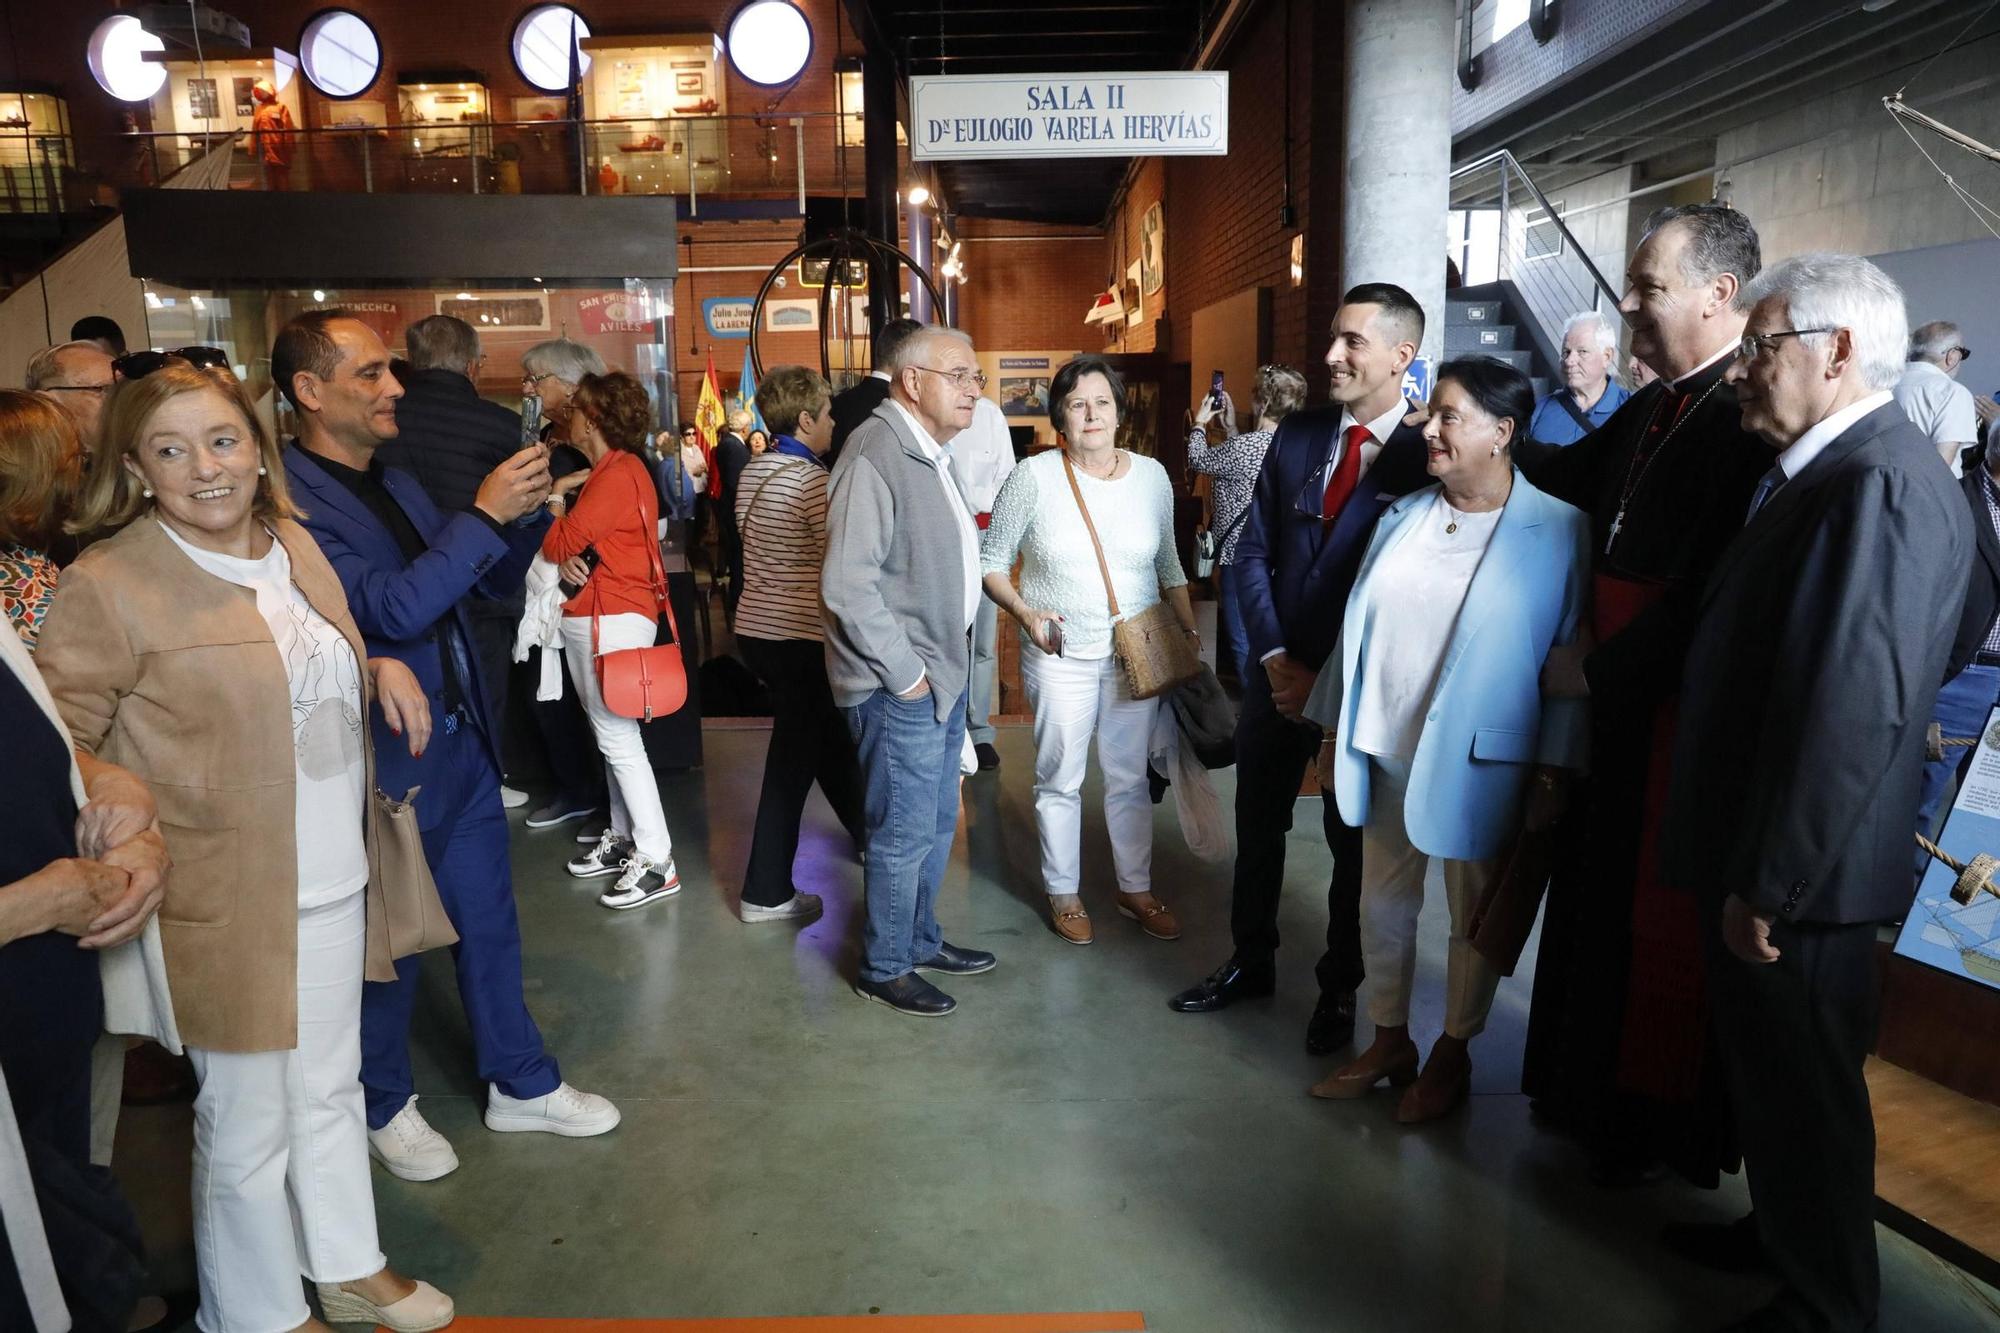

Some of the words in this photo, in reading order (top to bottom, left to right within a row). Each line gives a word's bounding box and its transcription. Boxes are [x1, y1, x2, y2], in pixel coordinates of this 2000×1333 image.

[1027, 84, 1095, 111] SALA
[1106, 84, 1125, 109] II
[955, 117, 1033, 142] EULOGIO
[1042, 114, 1115, 142] VARELA
[1123, 109, 1212, 141] HERVÍAS
[579, 296, 600, 310] SAN
[713, 307, 732, 318] Julio
[600, 321, 642, 333] AVILES
